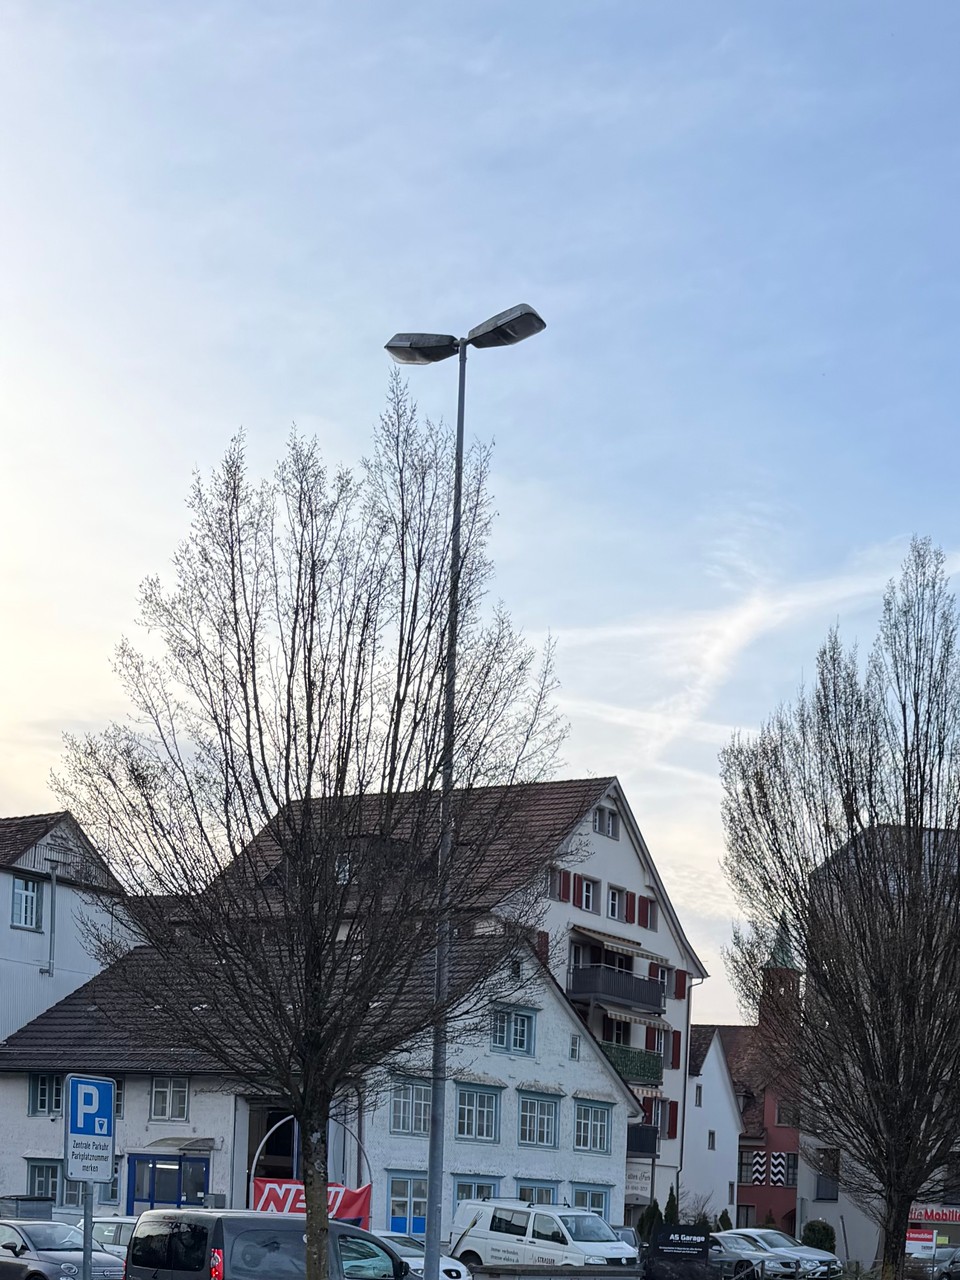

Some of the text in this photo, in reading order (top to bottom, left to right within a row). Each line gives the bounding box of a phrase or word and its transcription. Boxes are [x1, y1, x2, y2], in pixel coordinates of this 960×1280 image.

[77, 1083, 99, 1128] P
[72, 1140, 109, 1151] Zentrale Parkuhr
[71, 1151, 110, 1162] Parkplatznummer
[82, 1163, 98, 1172] merken
